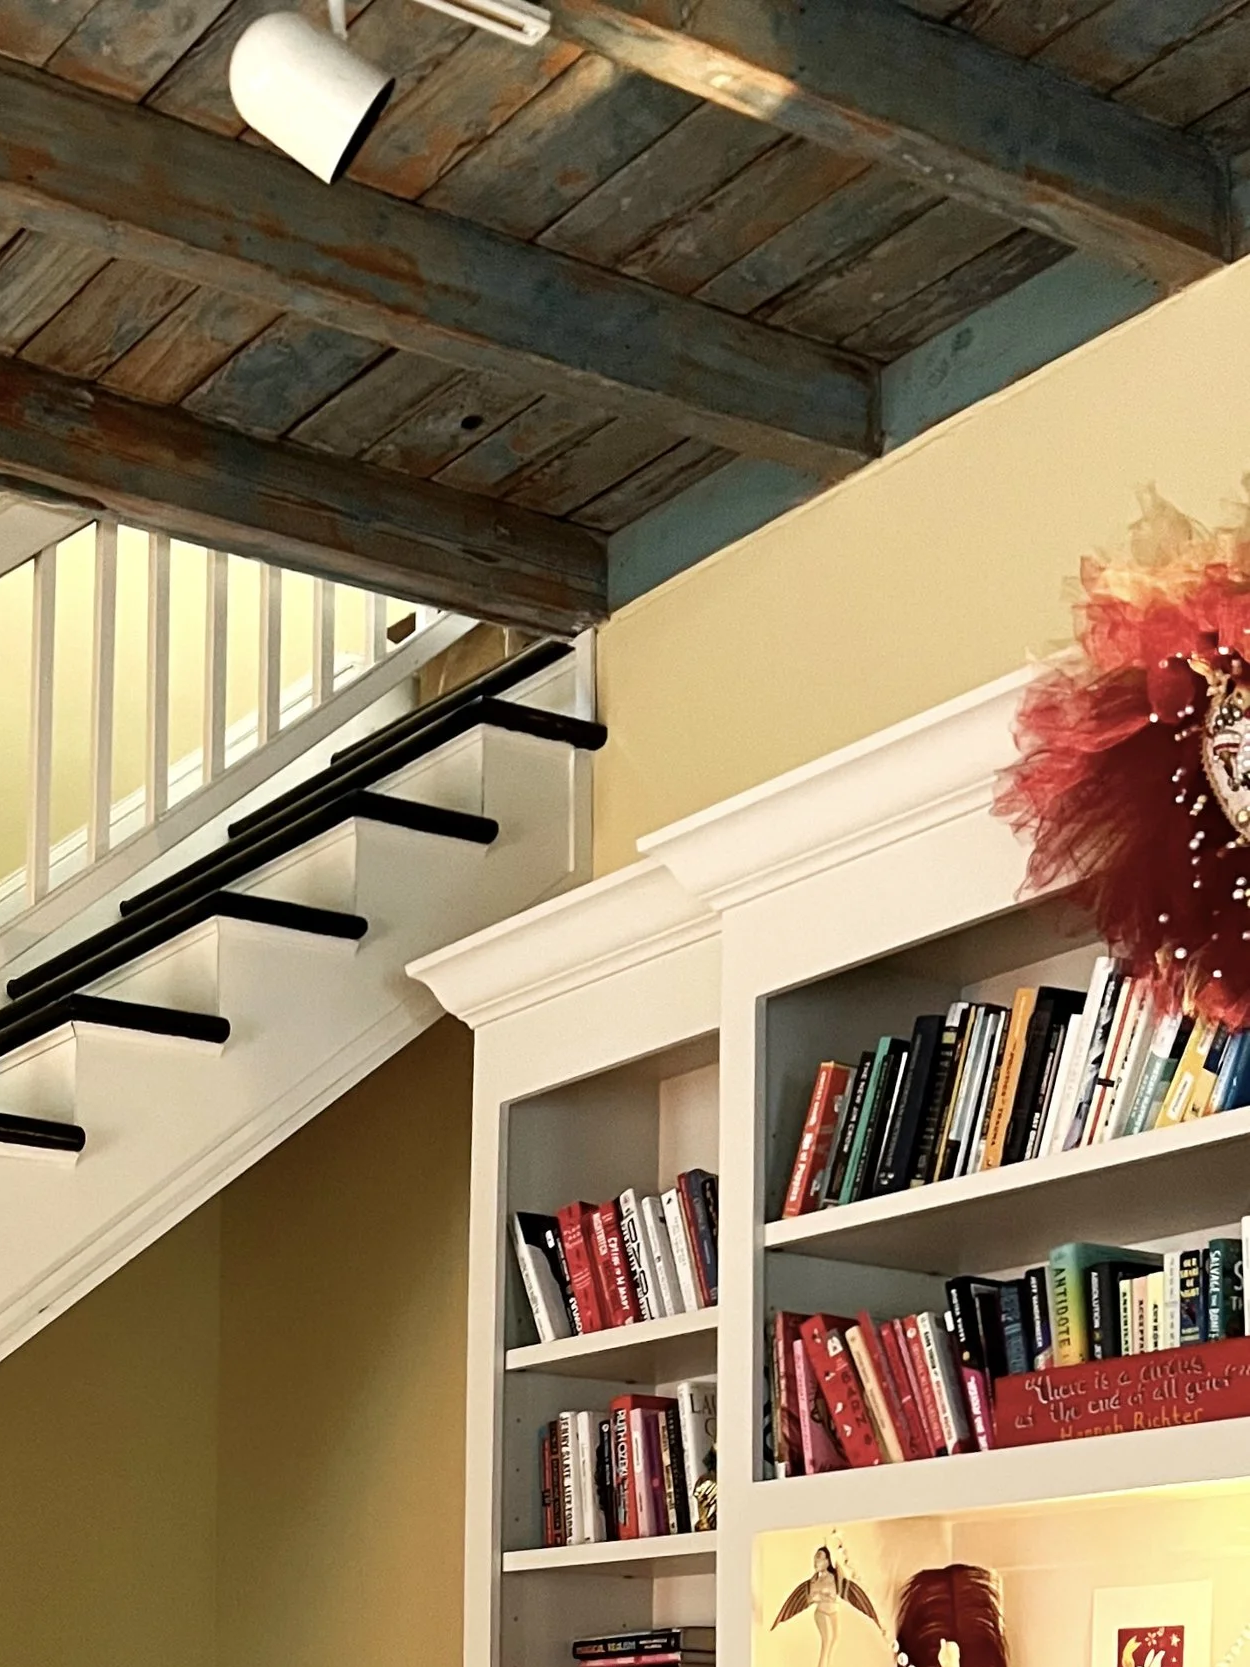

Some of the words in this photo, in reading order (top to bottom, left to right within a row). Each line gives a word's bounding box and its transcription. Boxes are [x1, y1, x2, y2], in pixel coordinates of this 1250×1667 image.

[842, 1123, 856, 1153] CROW
[1209, 1250, 1222, 1293] SALVAGE
[1052, 1267, 1071, 1350] ANTIDOTE
[1090, 1271, 1101, 1329] ABSOLUTION
[1087, 1388, 1122, 1414] end
[1152, 1377, 1178, 1401] all
[1094, 1371, 1110, 1390] is
[560, 1416, 570, 1449] JENNY
[615, 1409, 628, 1442] RUTH
[1133, 1405, 1204, 1430] Richter
